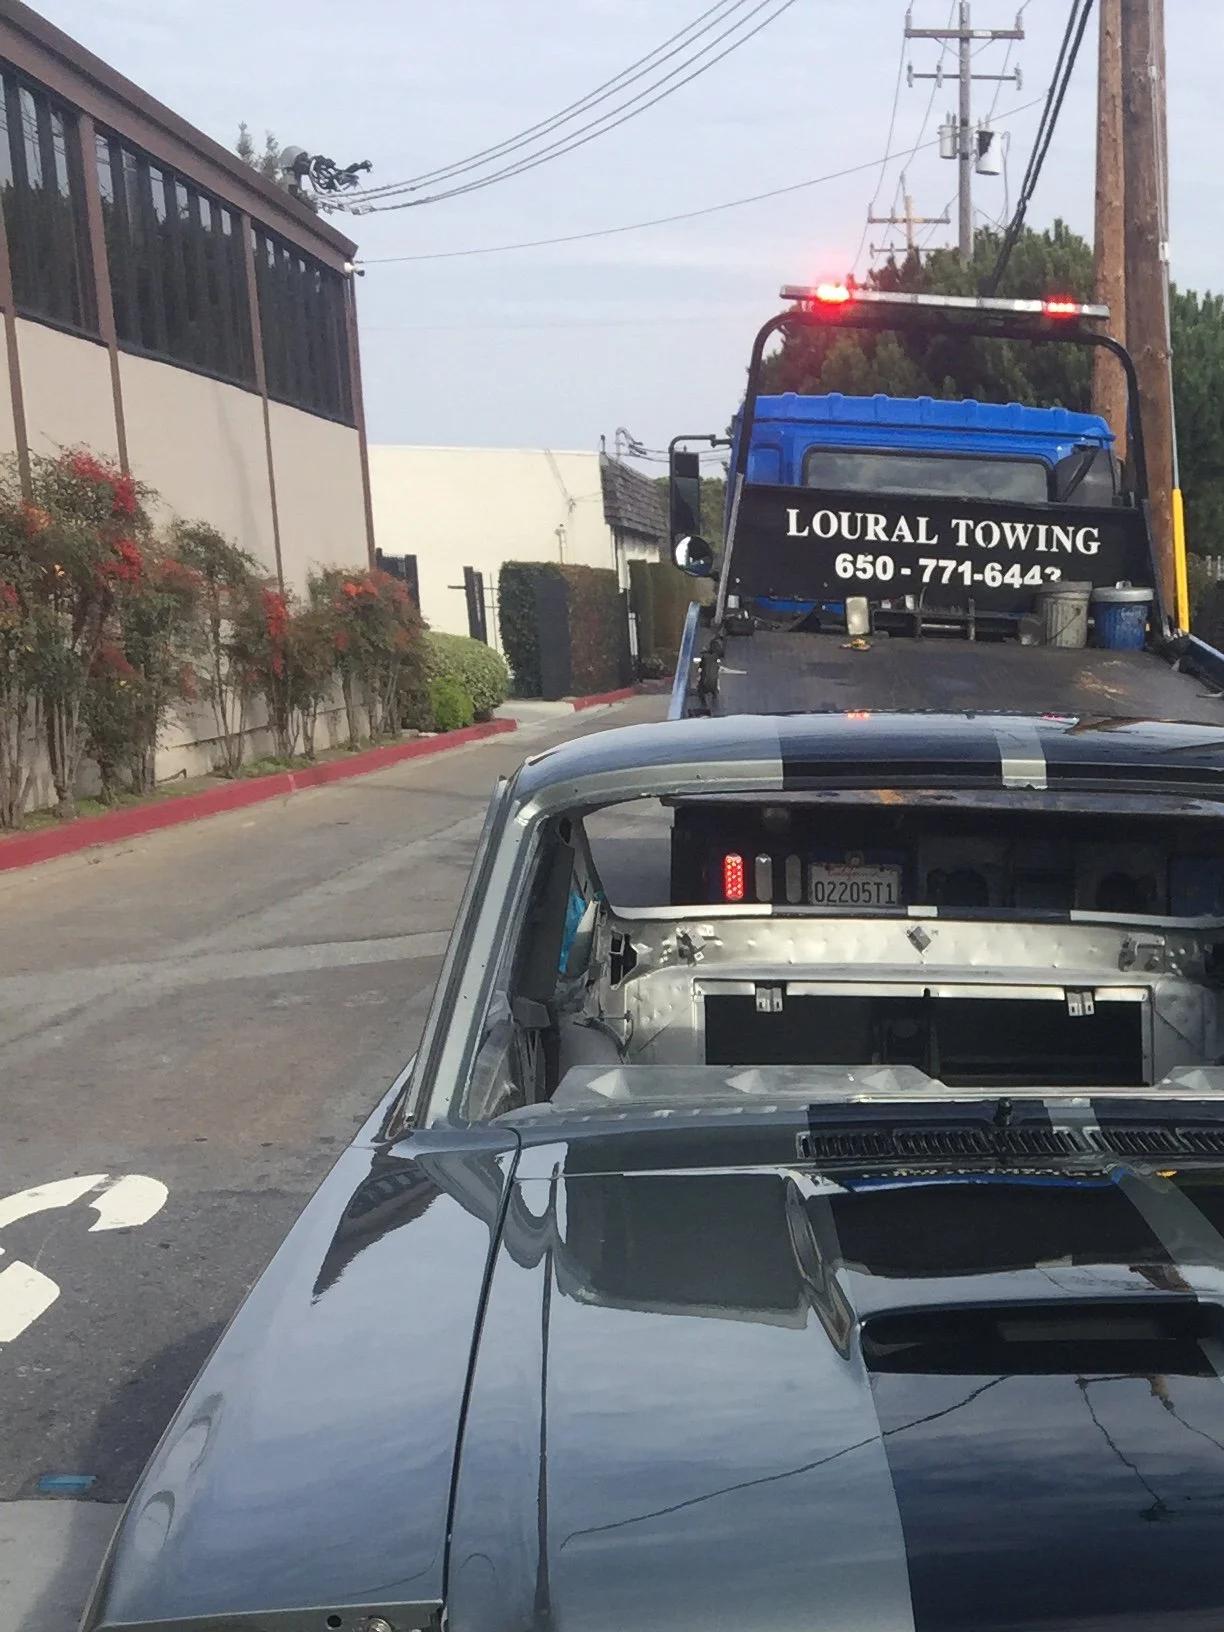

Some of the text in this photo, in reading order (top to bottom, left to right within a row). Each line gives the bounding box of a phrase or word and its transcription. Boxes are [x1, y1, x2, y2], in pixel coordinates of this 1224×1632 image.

[786, 508, 1101, 555] LOURAL TOWING
[835, 553, 894, 581] 650
[814, 881, 896, 905] 02205T1
